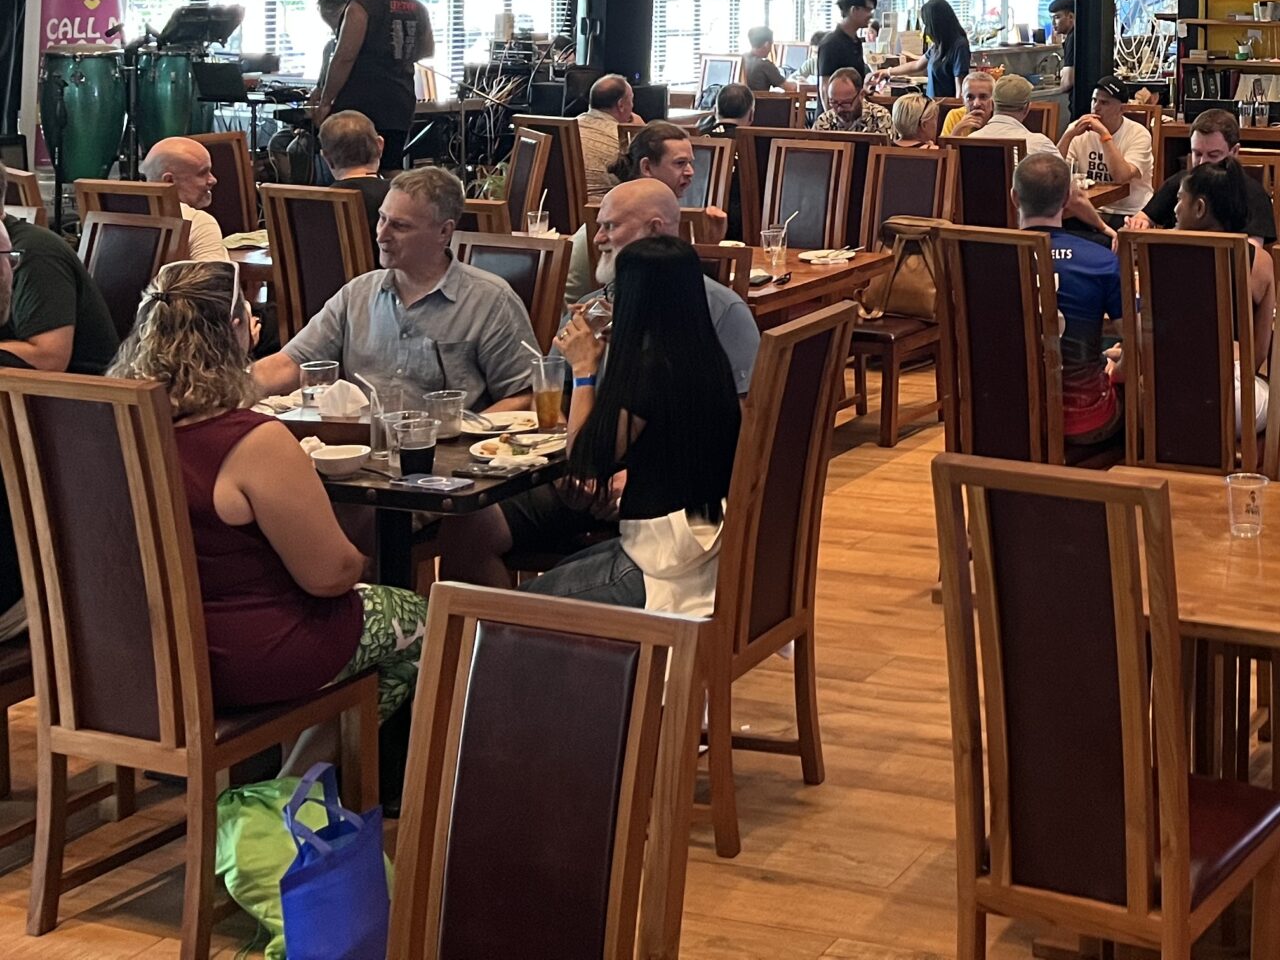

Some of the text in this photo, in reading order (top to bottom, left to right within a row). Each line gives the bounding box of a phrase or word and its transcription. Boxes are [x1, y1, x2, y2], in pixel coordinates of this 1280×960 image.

[47, 17, 101, 40] CALL
[1088, 150, 1104, 162] CU
[1050, 248, 1073, 260] ELTS
